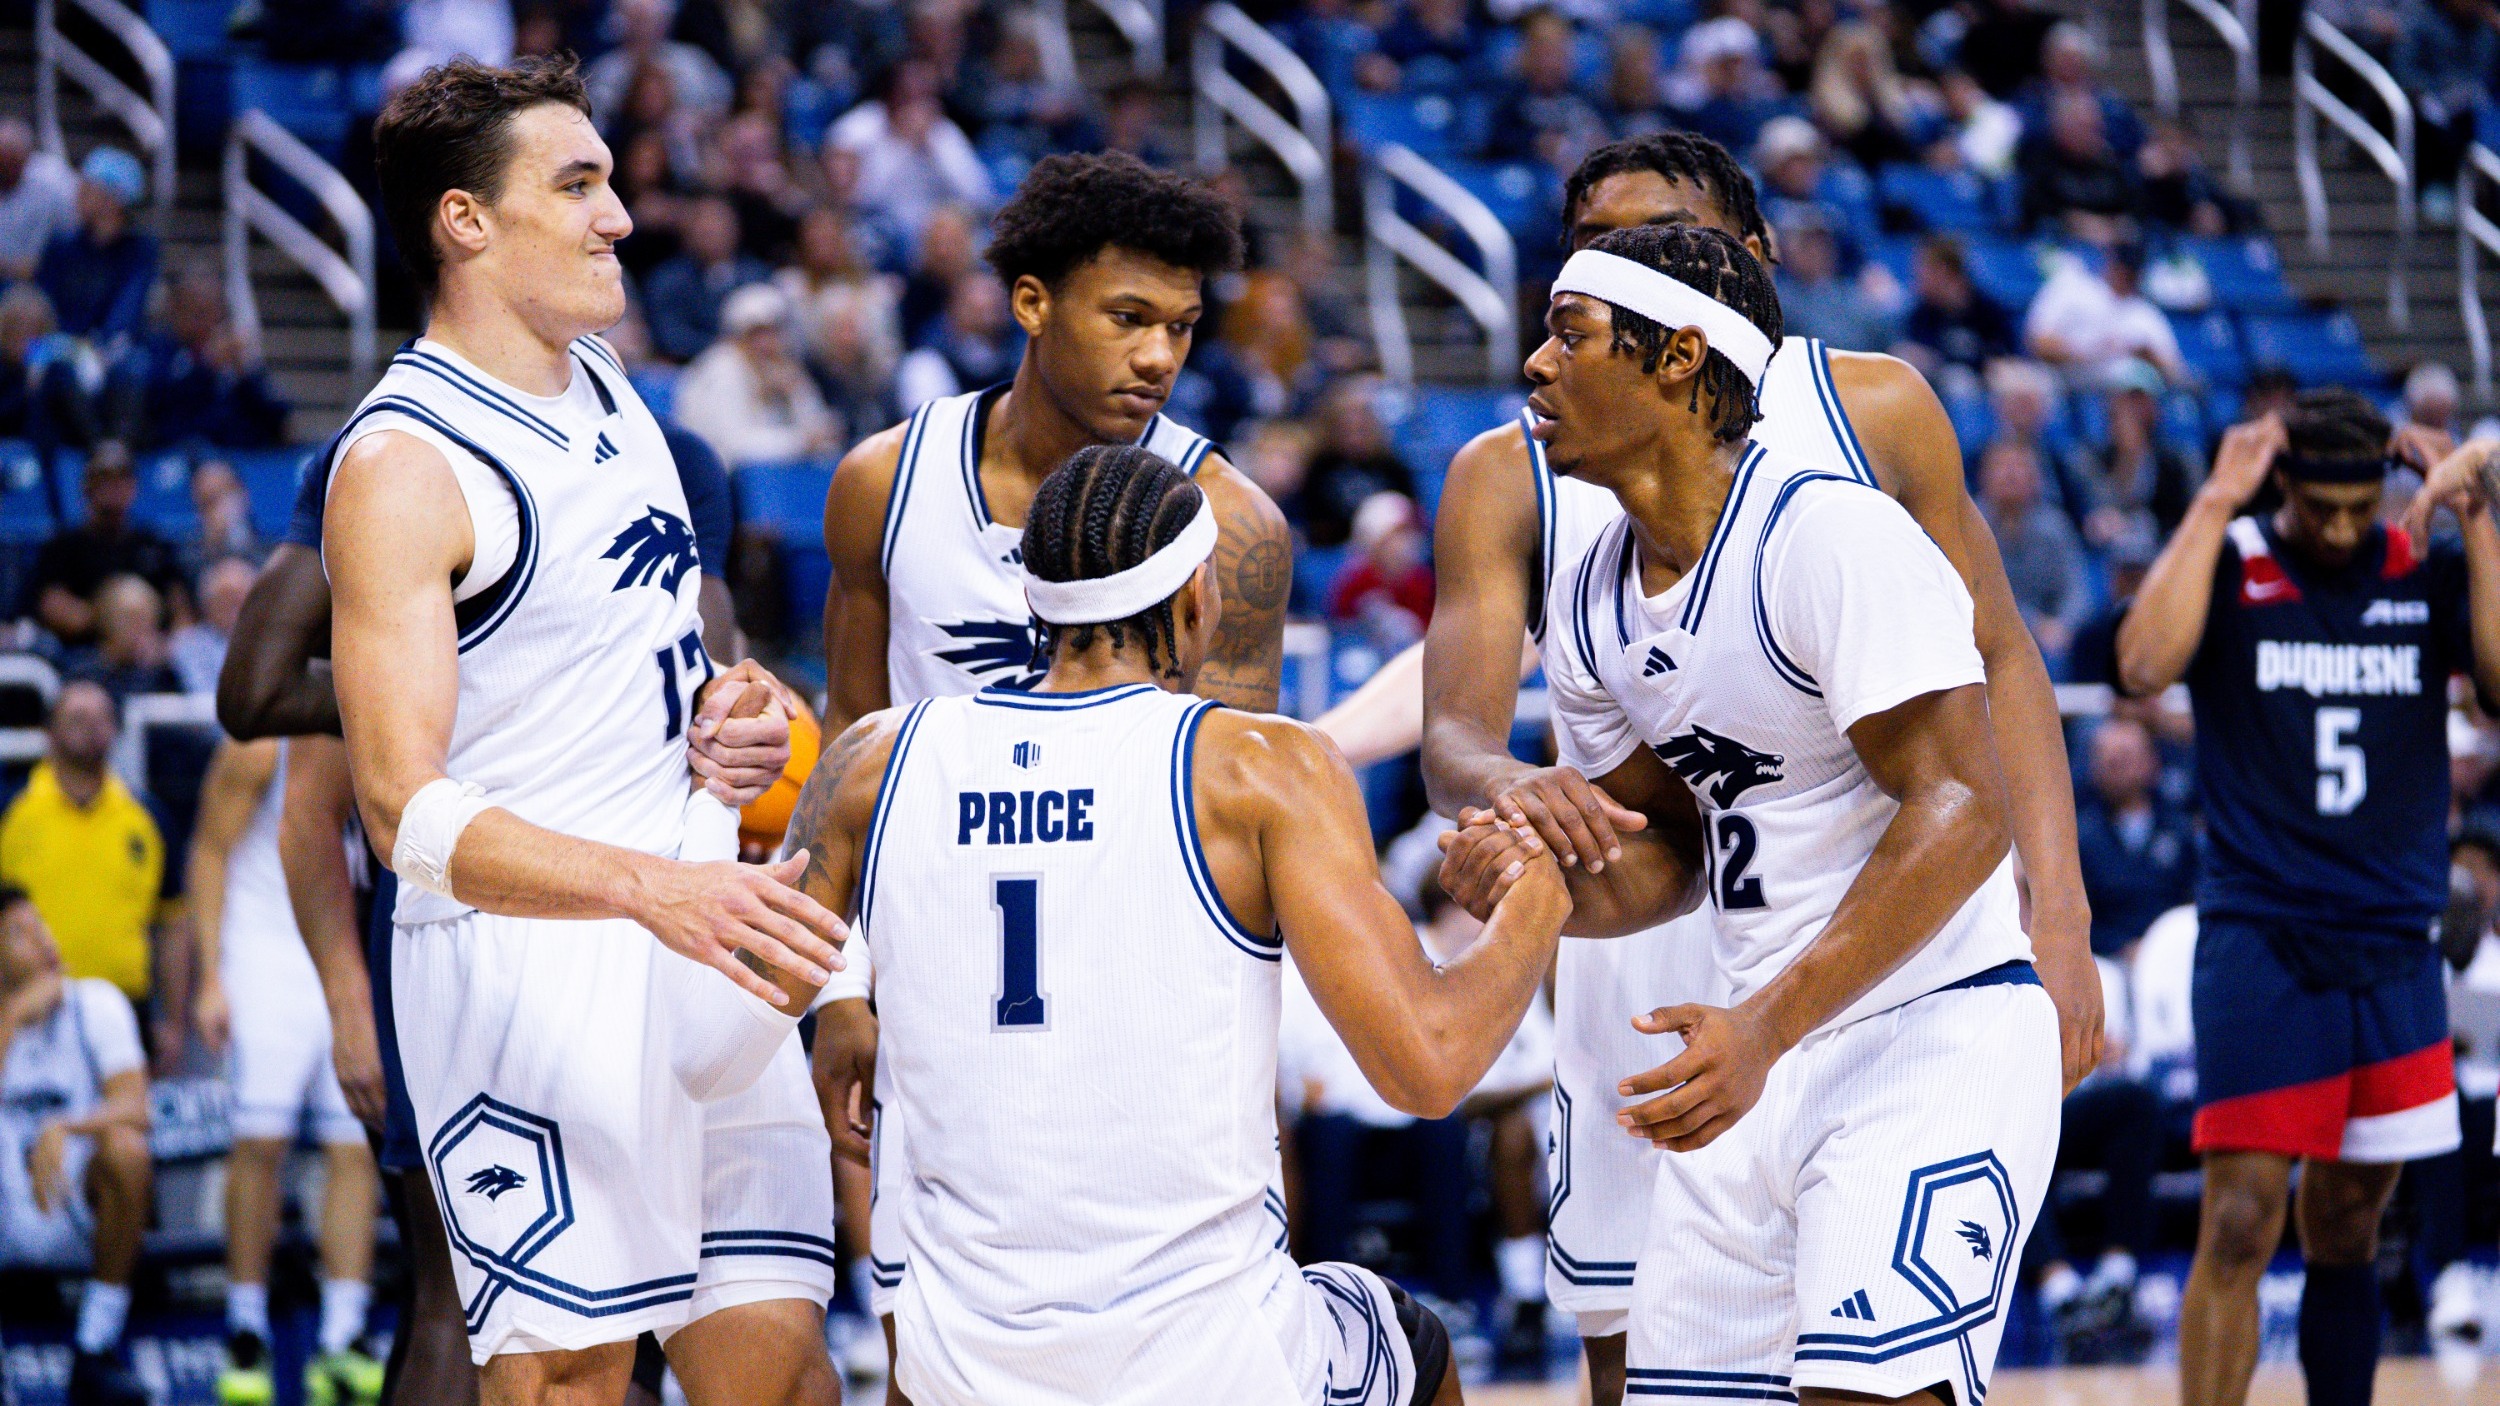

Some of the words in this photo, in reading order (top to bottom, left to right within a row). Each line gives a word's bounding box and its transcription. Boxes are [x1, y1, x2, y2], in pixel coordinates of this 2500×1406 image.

[2256, 639, 2422, 697] DUQUESNE
[2314, 705, 2368, 817] 5
[957, 788, 1094, 846] PRICE
[991, 873, 1051, 1032] 1
